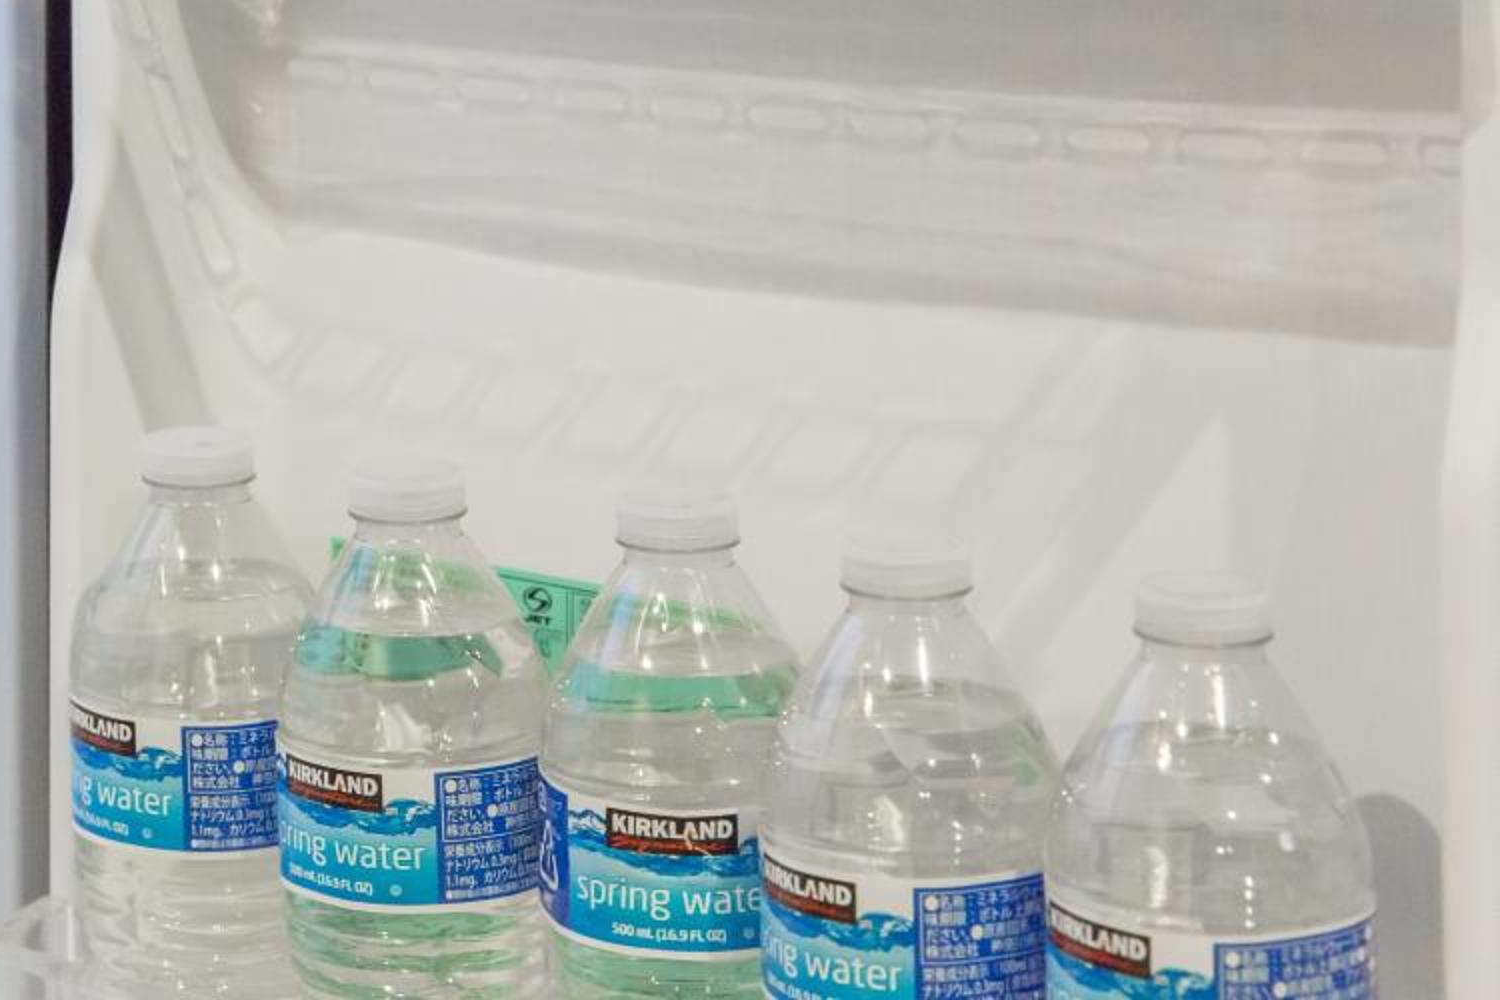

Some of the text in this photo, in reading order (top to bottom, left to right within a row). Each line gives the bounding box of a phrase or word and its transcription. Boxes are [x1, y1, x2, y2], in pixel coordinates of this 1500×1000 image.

[288, 758, 379, 798] KIRKLAND
[97, 781, 172, 816] water
[611, 813, 733, 840] KIRKLAND
[334, 840, 427, 871] water
[577, 875, 671, 922] spring
[682, 886, 761, 916] wate
[765, 859, 852, 907] KIRKLAND
[611, 921, 635, 937] 500
[656, 928, 688, 943] (16.9
[804, 951, 902, 992] water
